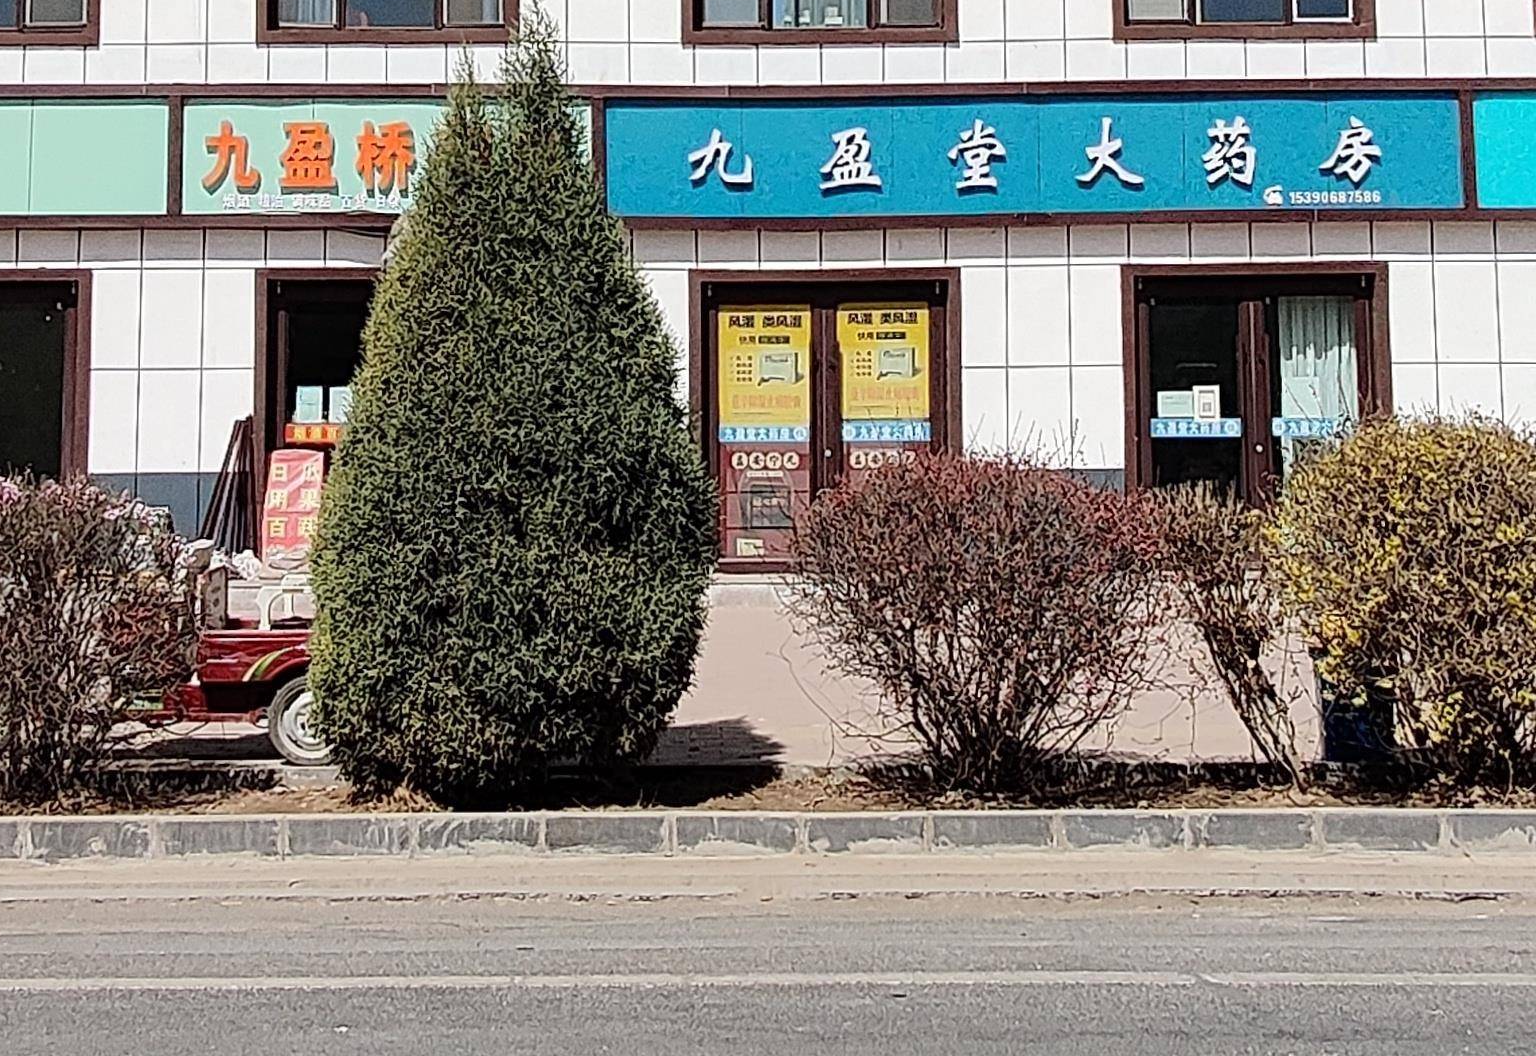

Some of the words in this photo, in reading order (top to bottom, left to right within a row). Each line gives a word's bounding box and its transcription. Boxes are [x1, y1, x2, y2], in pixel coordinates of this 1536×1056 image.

[201, 120, 484, 194] 九盈桥
[688, 116, 1382, 193] 九盈堂大药房
[1288, 190, 1382, 204] 15390687586
